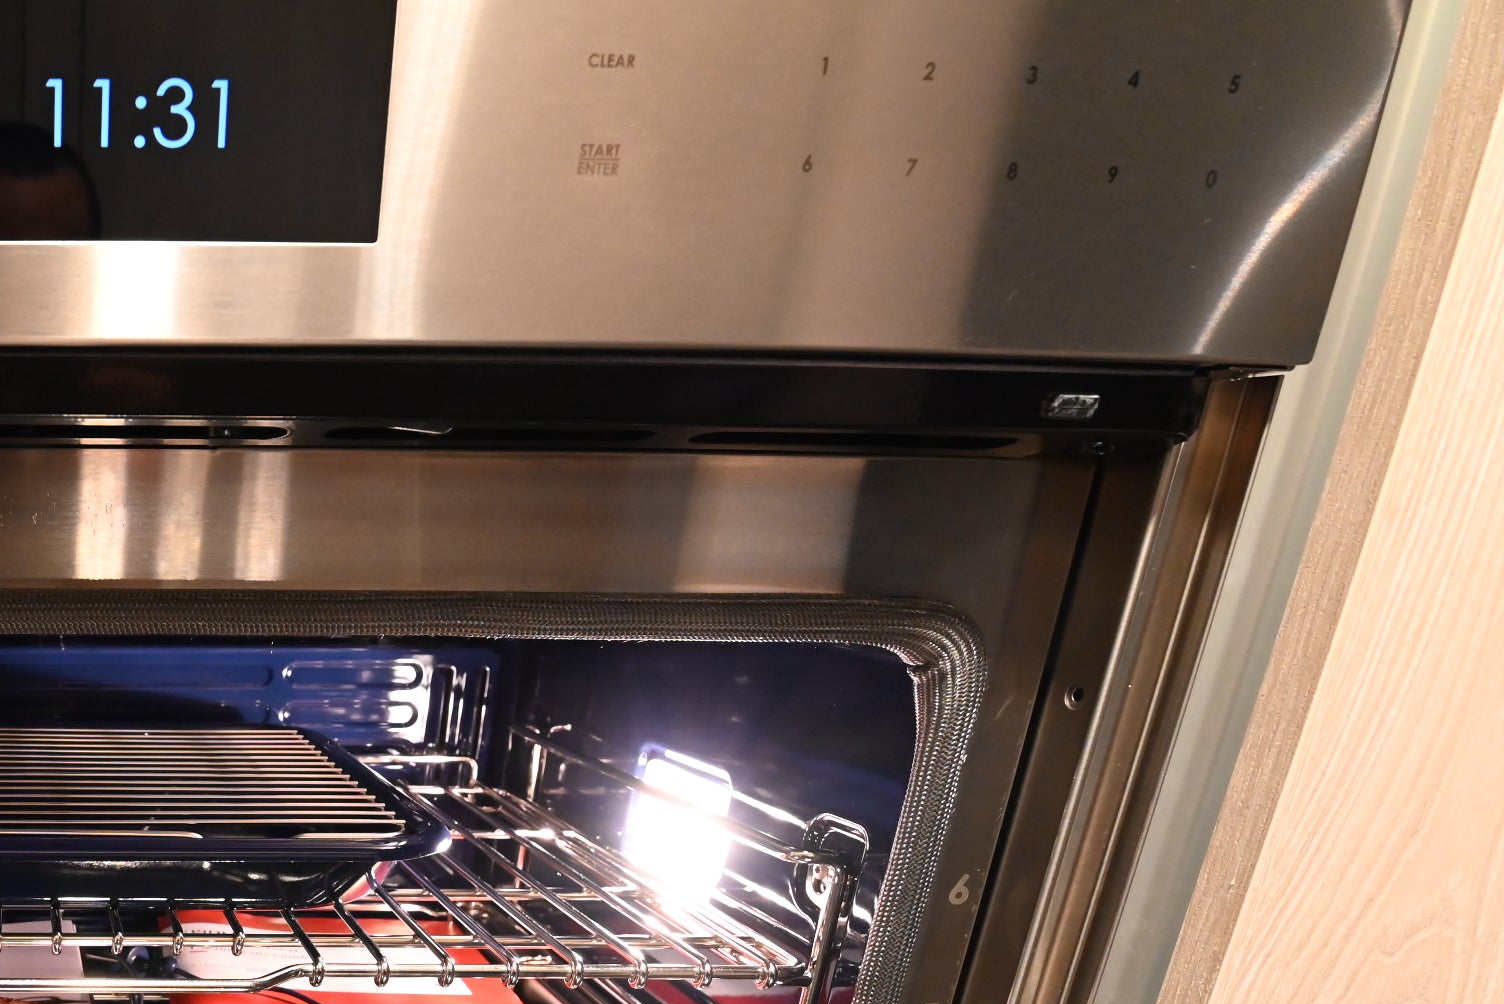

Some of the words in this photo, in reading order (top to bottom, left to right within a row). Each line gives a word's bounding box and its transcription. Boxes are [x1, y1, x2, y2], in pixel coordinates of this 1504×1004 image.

[588, 52, 636, 69] CLEAR
[922, 61, 937, 82] 2
[1025, 65, 1039, 86] 3
[1127, 70, 1141, 89] 4
[1227, 74, 1242, 94] 5
[46, 78, 228, 148] 11:31
[581, 144, 621, 158] START
[576, 161, 619, 177] ENTER
[801, 154, 813, 174] 6
[905, 157, 919, 177] 7
[1005, 161, 1019, 181] 8
[1107, 165, 1119, 184] 9
[1204, 169, 1219, 189] 0
[948, 873, 971, 905] 6
